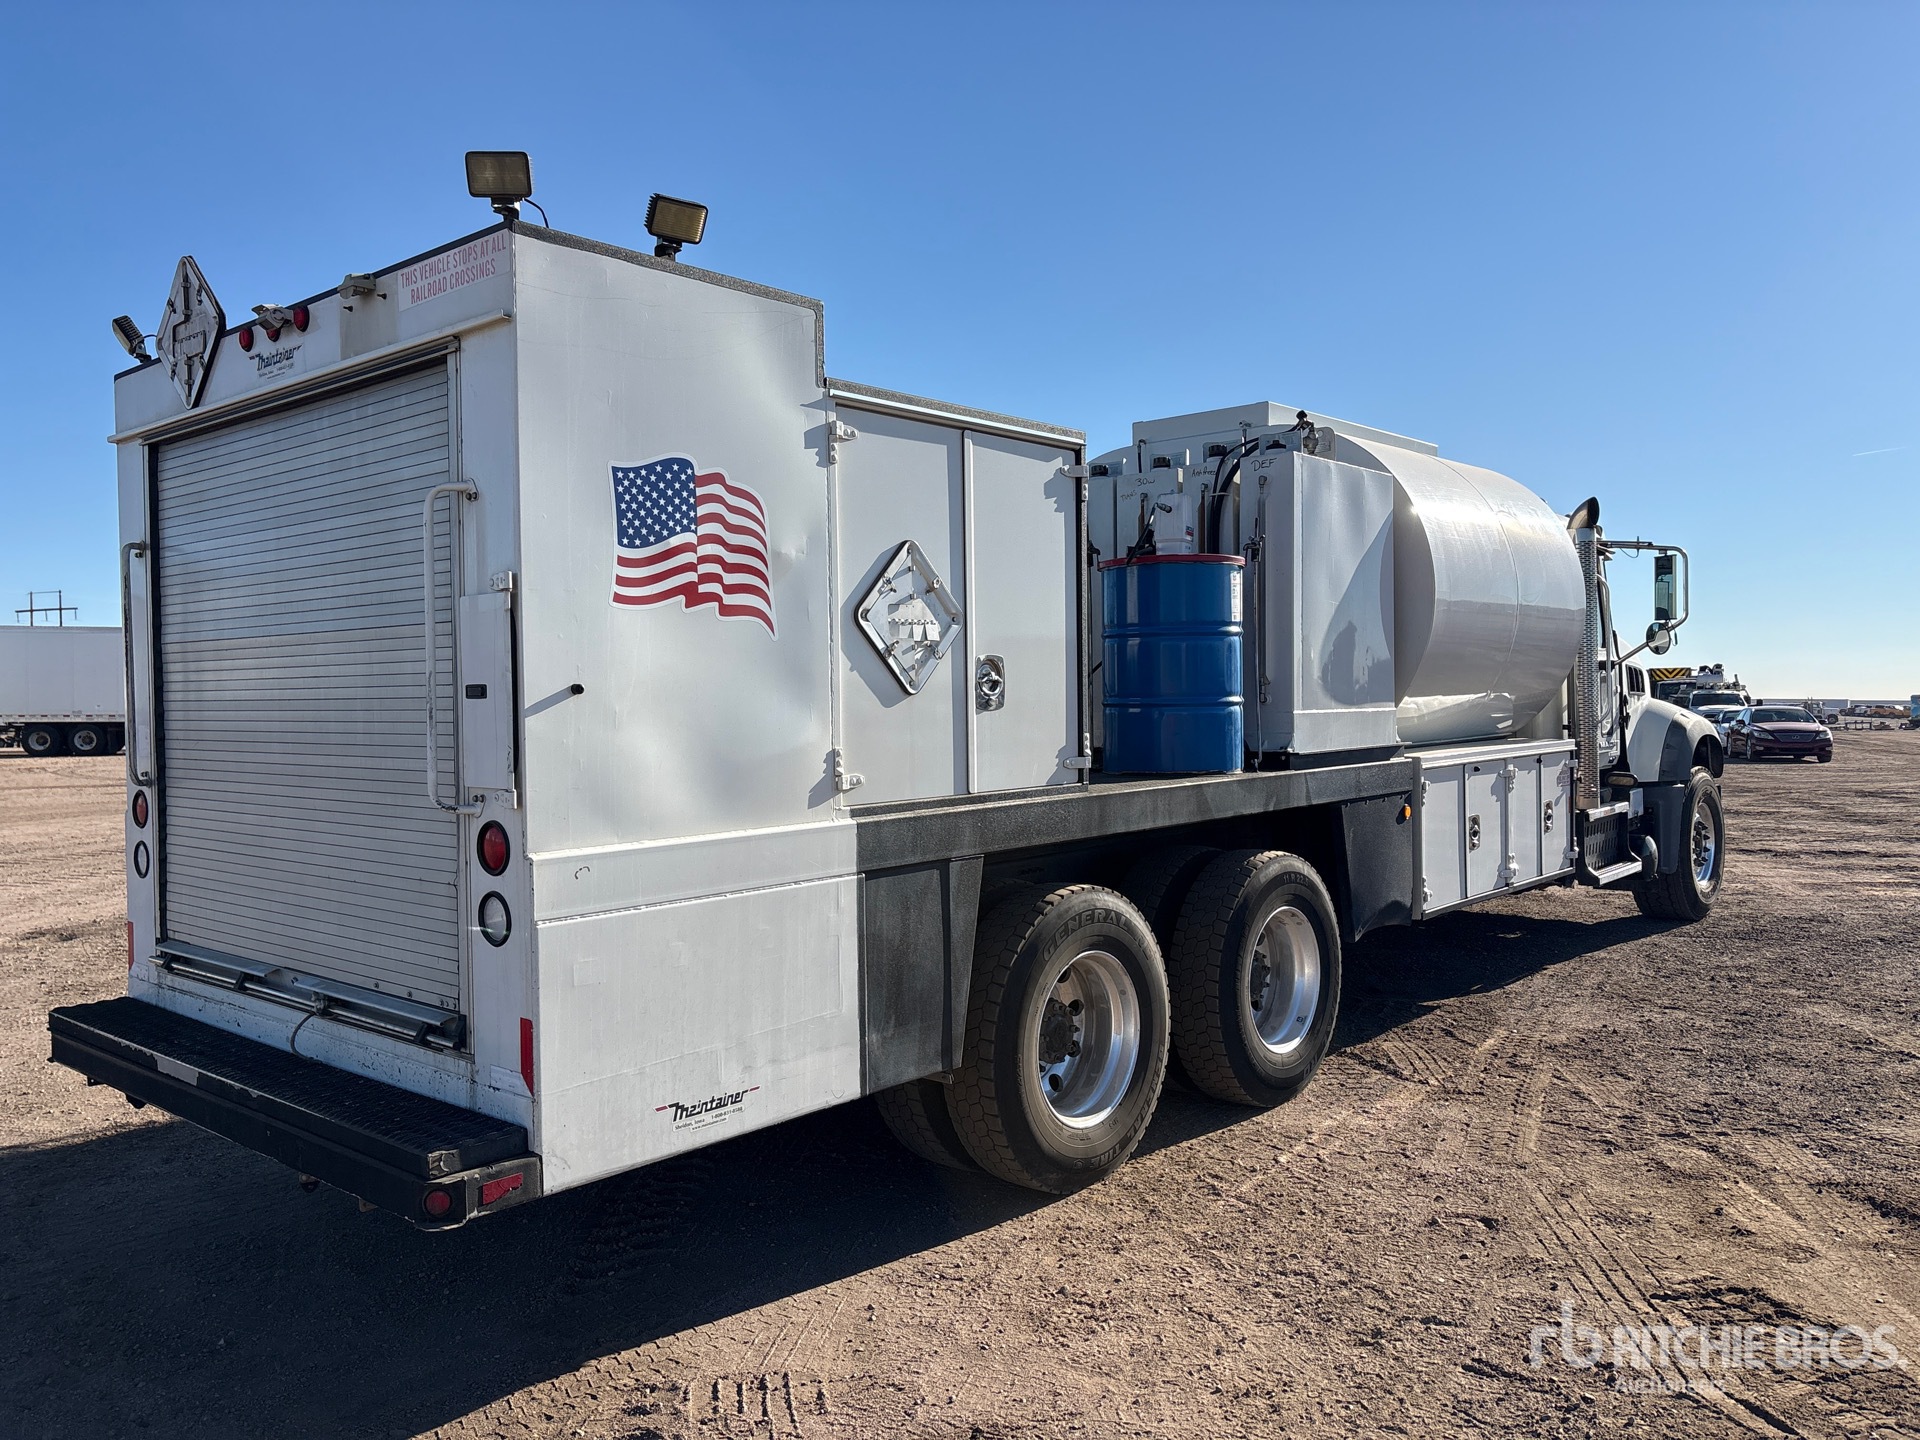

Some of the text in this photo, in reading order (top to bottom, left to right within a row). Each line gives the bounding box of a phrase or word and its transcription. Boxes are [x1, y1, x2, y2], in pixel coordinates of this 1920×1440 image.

[400, 233, 507, 289] THIS VEHICLE STOPS AT ALL
[410, 258, 496, 305] RAILROAD CROSSINGS
[1250, 457, 1278, 472] DEF
[1043, 909, 1129, 962] GENERAL
[668, 1089, 749, 1123] Maintainer
